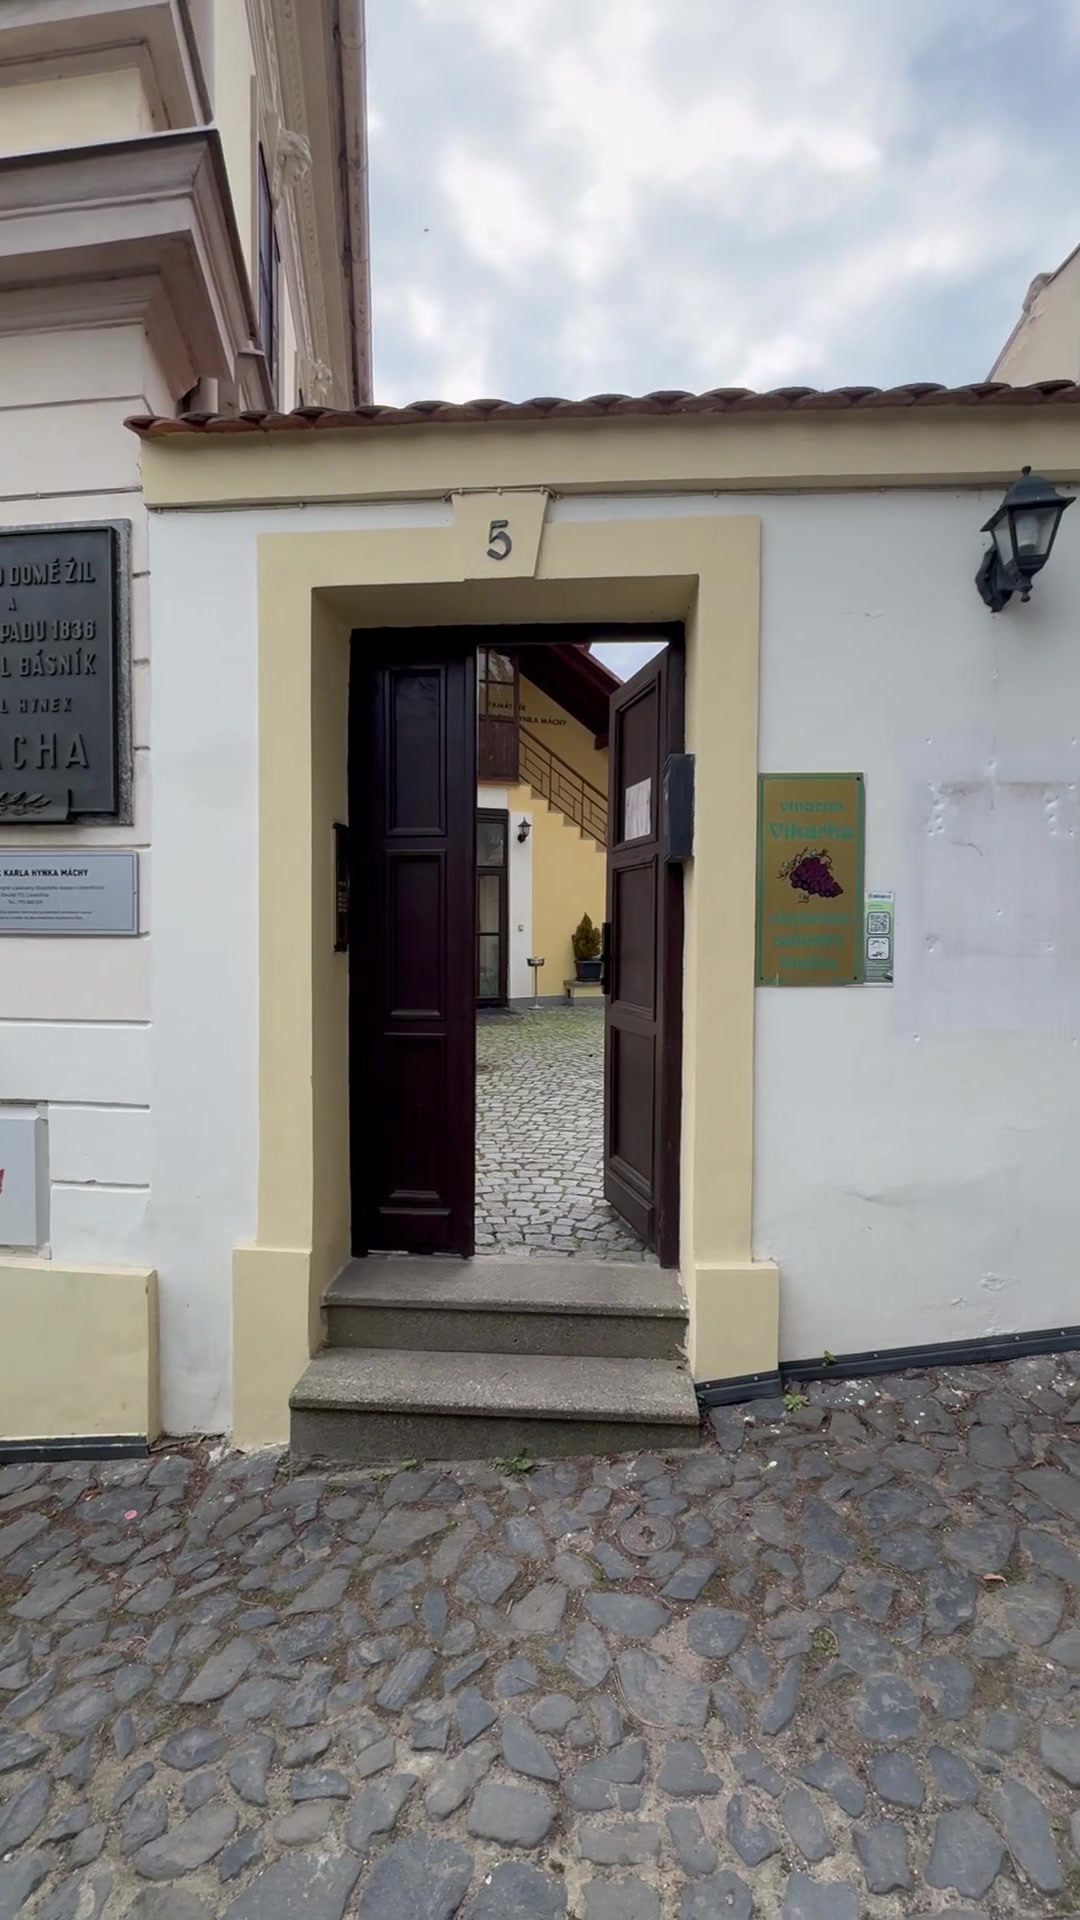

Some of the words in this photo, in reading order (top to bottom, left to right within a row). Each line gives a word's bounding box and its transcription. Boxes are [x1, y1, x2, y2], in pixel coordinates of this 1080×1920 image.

[486, 519, 513, 561] 5
[51, 619, 97, 642] 1836
[19, 647, 97, 677] BÁSNÍK
[19, 697, 73, 714] HYNEK
[0, 732, 91, 770] CHA
[3, 868, 30, 877] KARLA
[31, 868, 59, 877] HYNKA
[60, 866, 89, 877] MÁCHY
